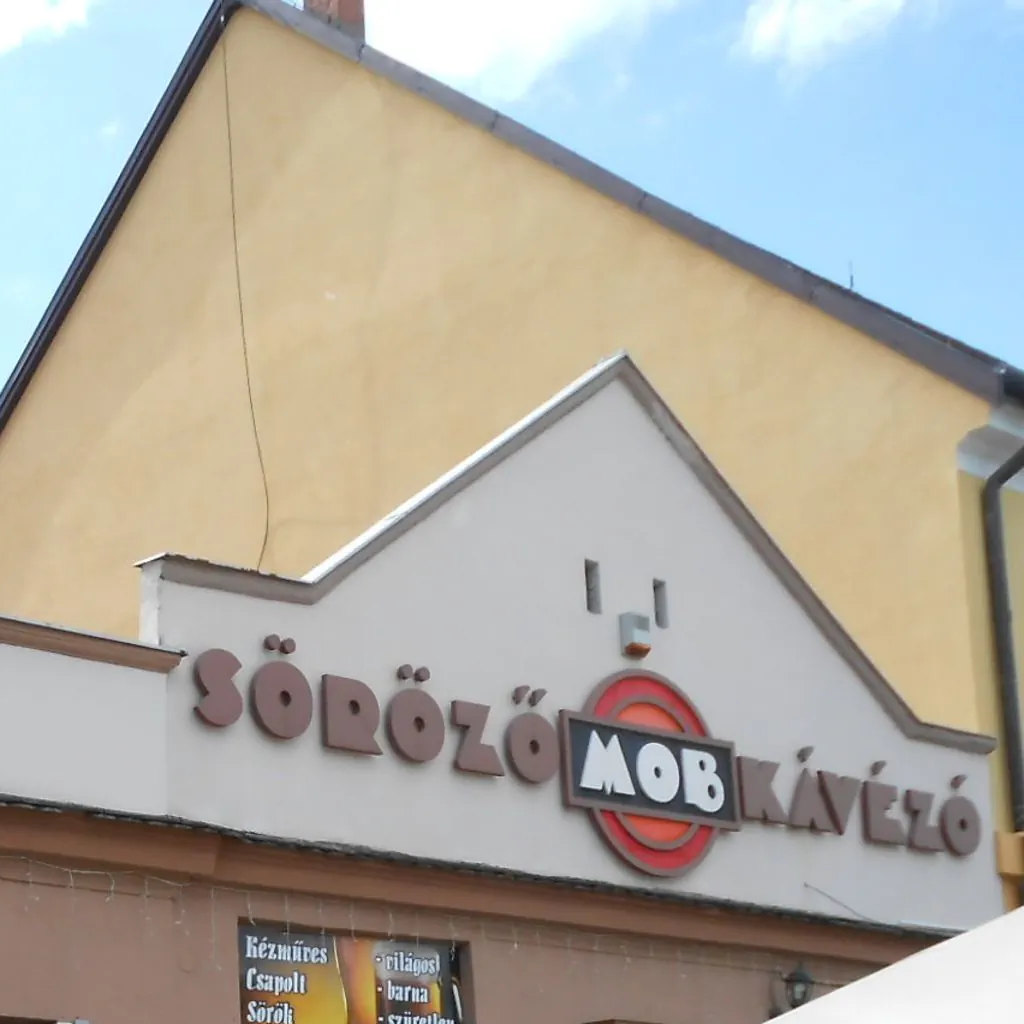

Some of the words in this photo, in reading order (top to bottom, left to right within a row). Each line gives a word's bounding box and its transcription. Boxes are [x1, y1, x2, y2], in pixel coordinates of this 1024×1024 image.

[194, 634, 560, 784] SÖRÖZŐ
[579, 729, 725, 813] MOB
[737, 746, 982, 858] KÁVÉZÓ
[245, 935, 328, 964] Kézműves
[246, 967, 306, 996] Csapolt
[387, 979, 429, 1004] barna
[246, 1000, 294, 1024] Sörök
